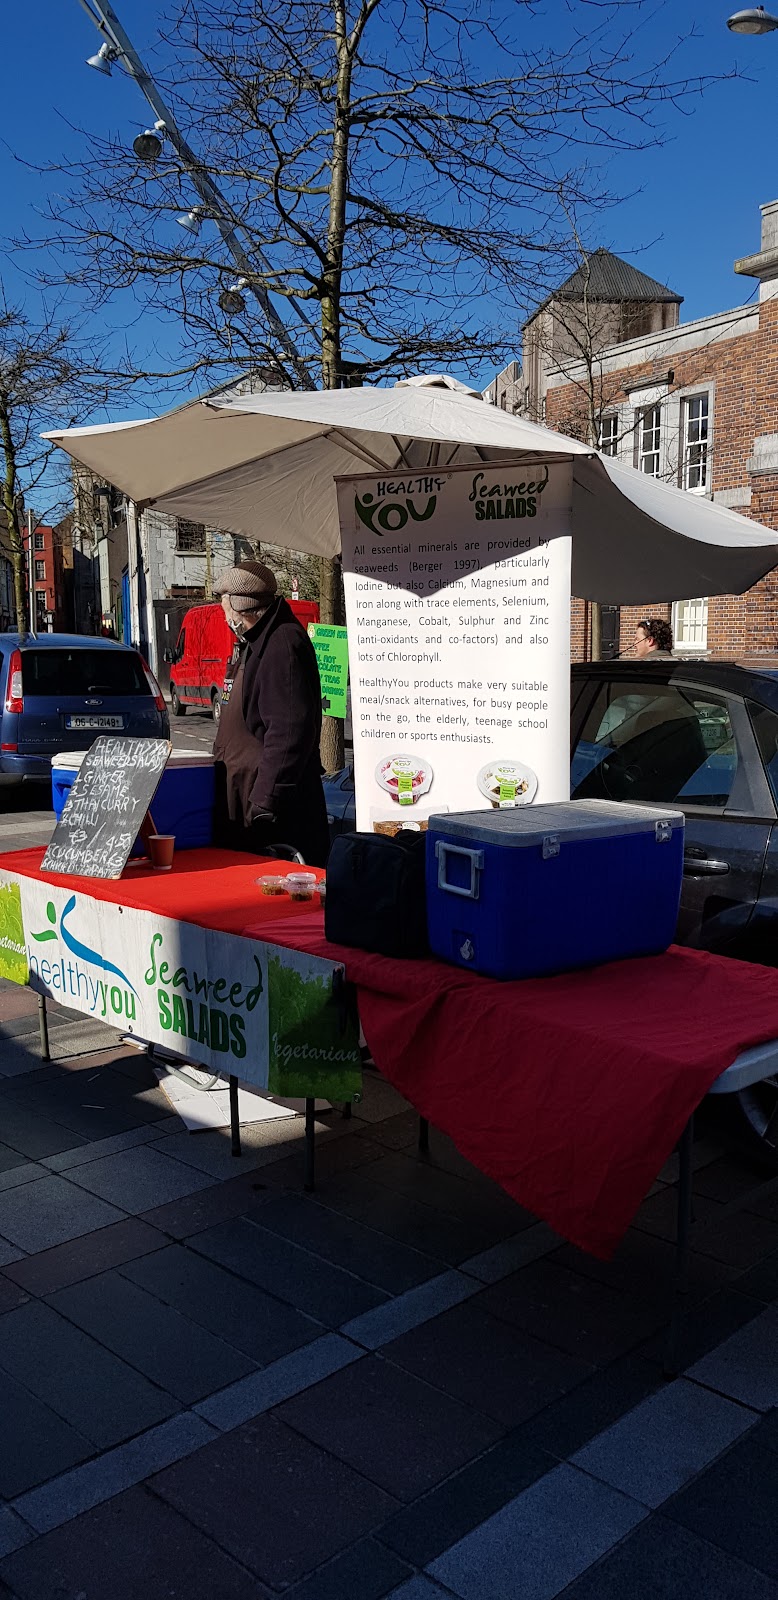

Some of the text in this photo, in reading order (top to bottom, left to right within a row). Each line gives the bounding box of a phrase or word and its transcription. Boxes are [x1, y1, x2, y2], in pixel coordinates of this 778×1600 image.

[377, 477, 446, 496] HEALTHY
[468, 465, 549, 501] Seaweed
[475, 497, 537, 521] SALADS
[354, 536, 550, 555] All essential minerals are provided by
[355, 556, 550, 573] seaweeds (Berger 1997), particularly
[355, 576, 549, 591] Iodine but also Calcium, Magnesium and
[356, 597, 549, 611] Iron along with trace elements, Selenium,
[356, 615, 549, 629] Manganese, Cobalt, Sulphur and Zinc
[357, 634, 549, 646] (anti-oxidants and co-factors) and also
[358, 652, 442, 664] lots of Chlorophyll.
[359, 677, 548, 692] HealthyYou products make very suitable
[359, 695, 548, 712] meal/snack alternatives, for busy people
[360, 712, 548, 729] on the go, the elderly, teenage school
[360, 729, 494, 744] children or sports enthusiasts.
[145, 932, 264, 1012] Seaweed
[157, 988, 247, 1059] SALADS
